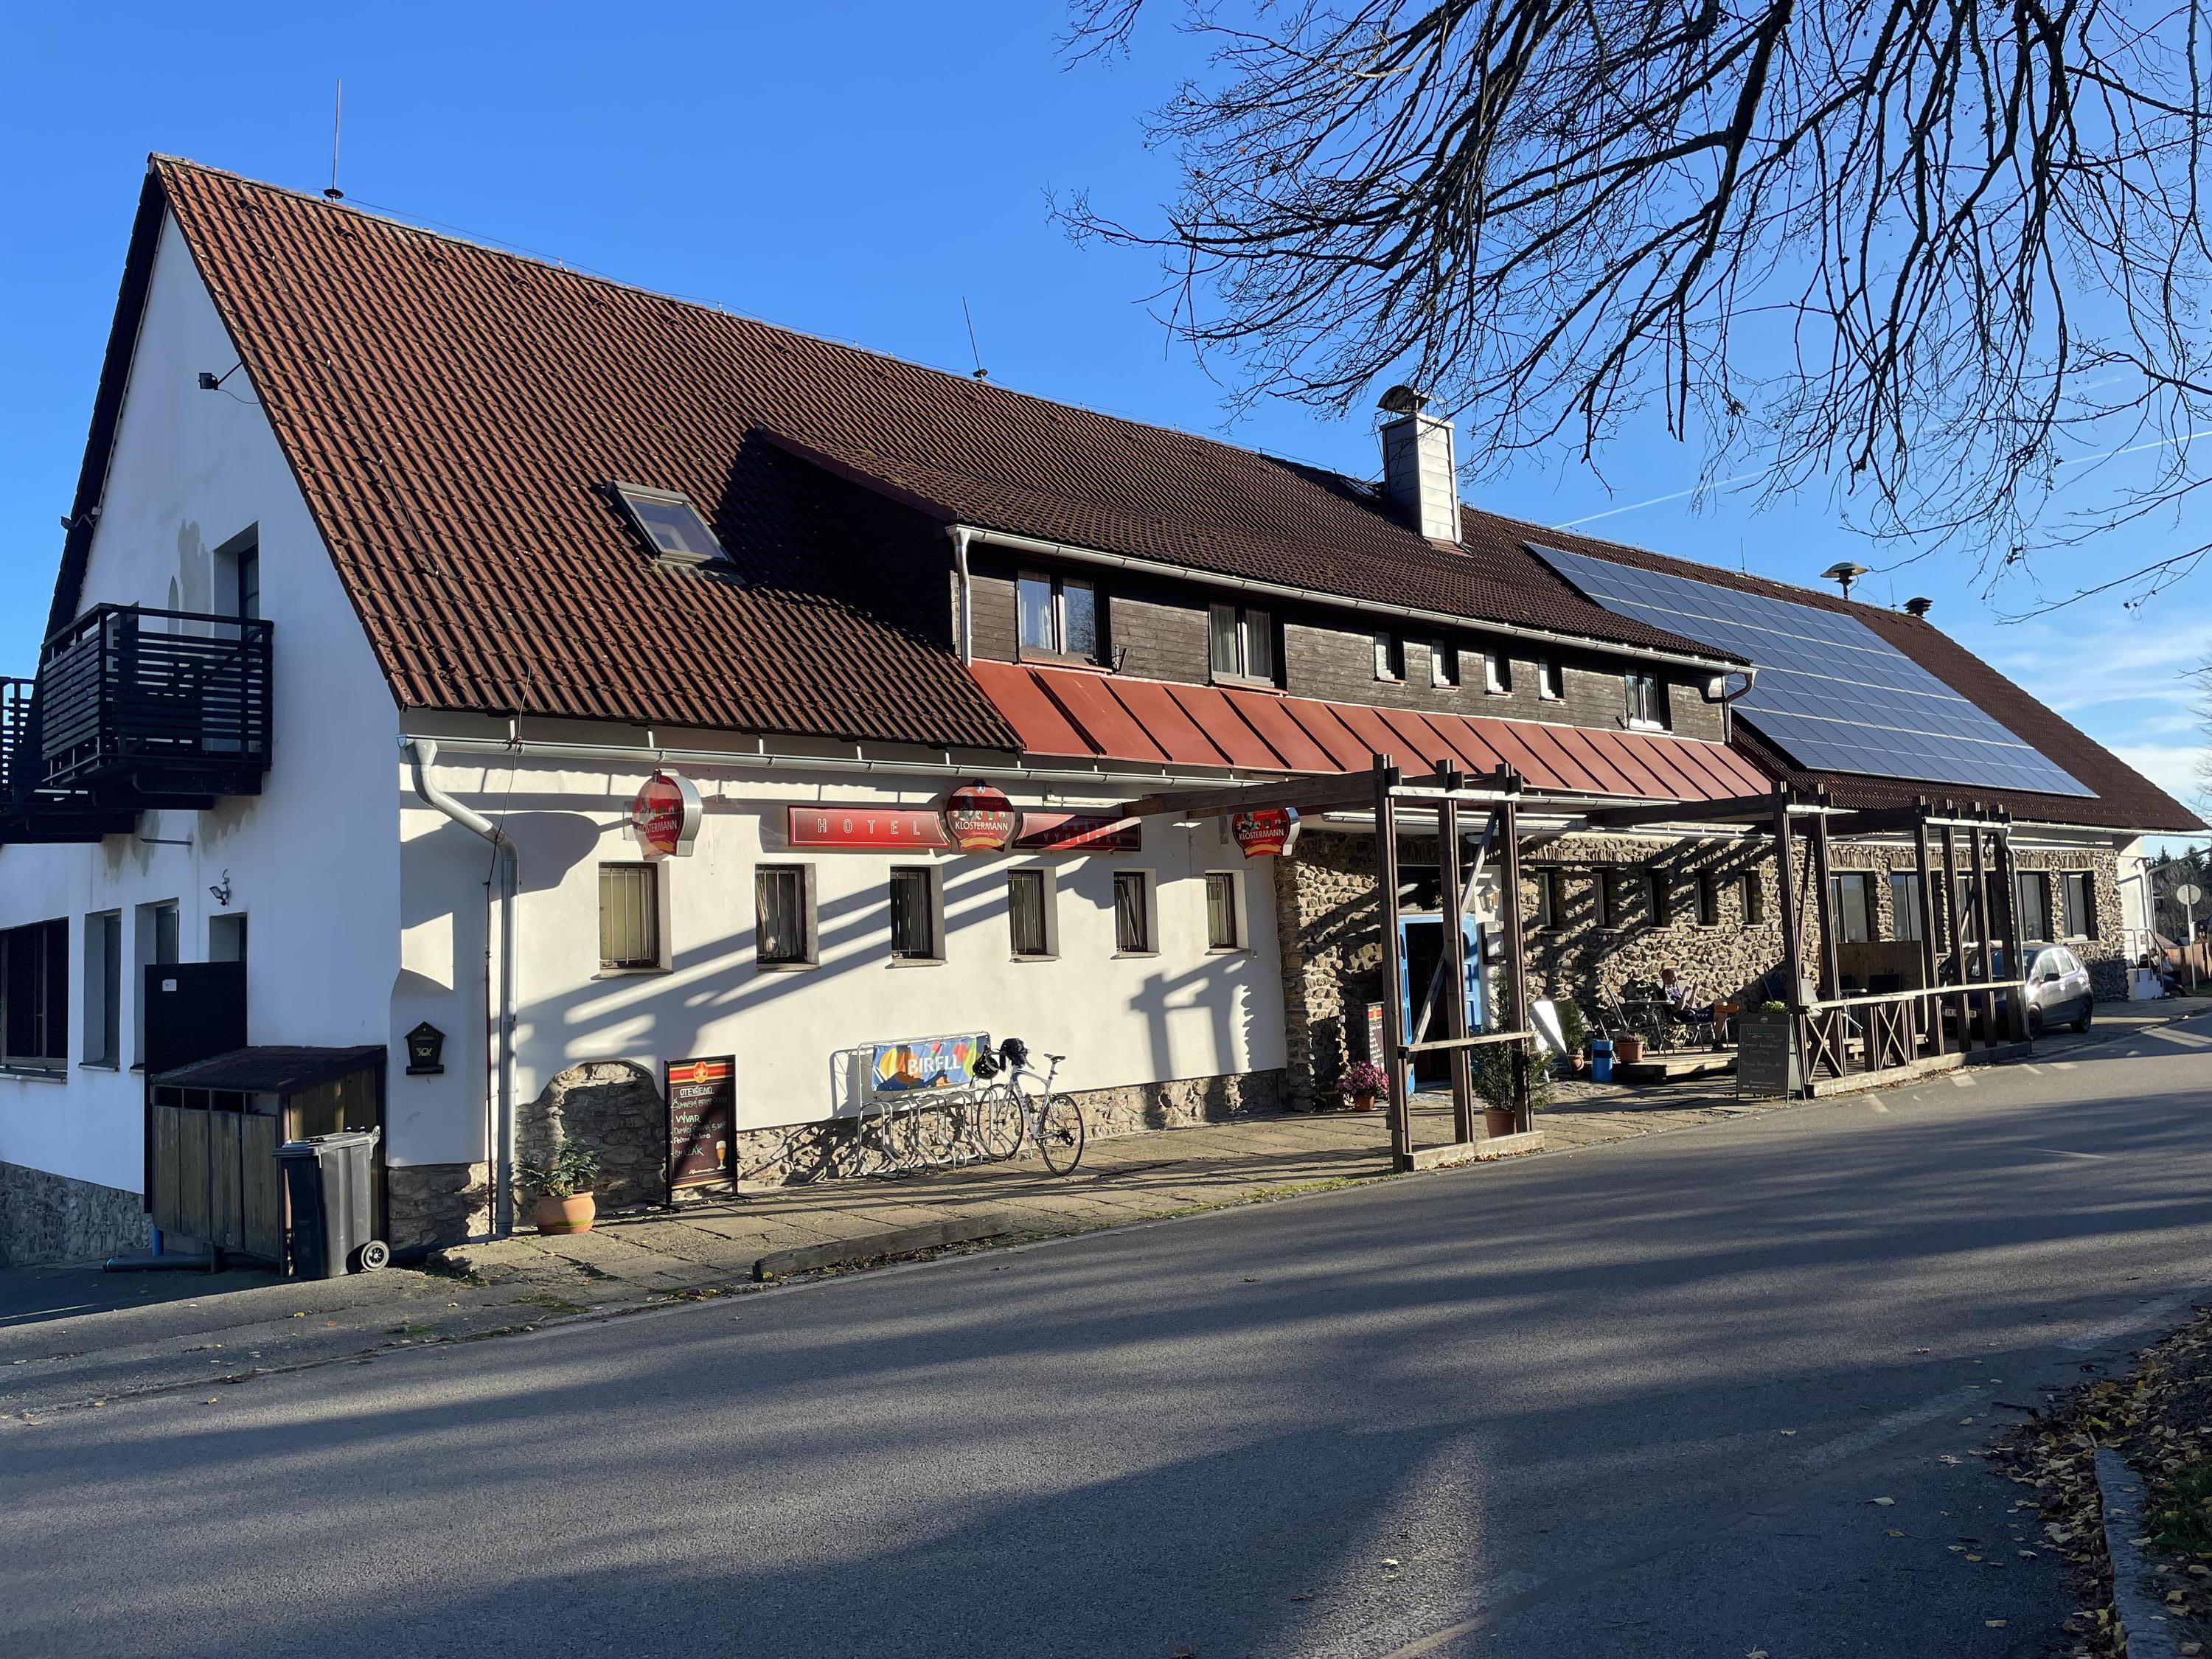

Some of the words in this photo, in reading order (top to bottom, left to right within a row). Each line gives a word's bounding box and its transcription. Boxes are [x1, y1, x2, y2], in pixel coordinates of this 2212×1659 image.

[818, 818, 920, 835] HOTEL
[955, 821, 1008, 830] KLOSTERMANN
[1239, 829, 1284, 841] KLOSTERMANN
[908, 1054, 961, 1075] BIRELL
[675, 1111, 701, 1124] VÝVAR
